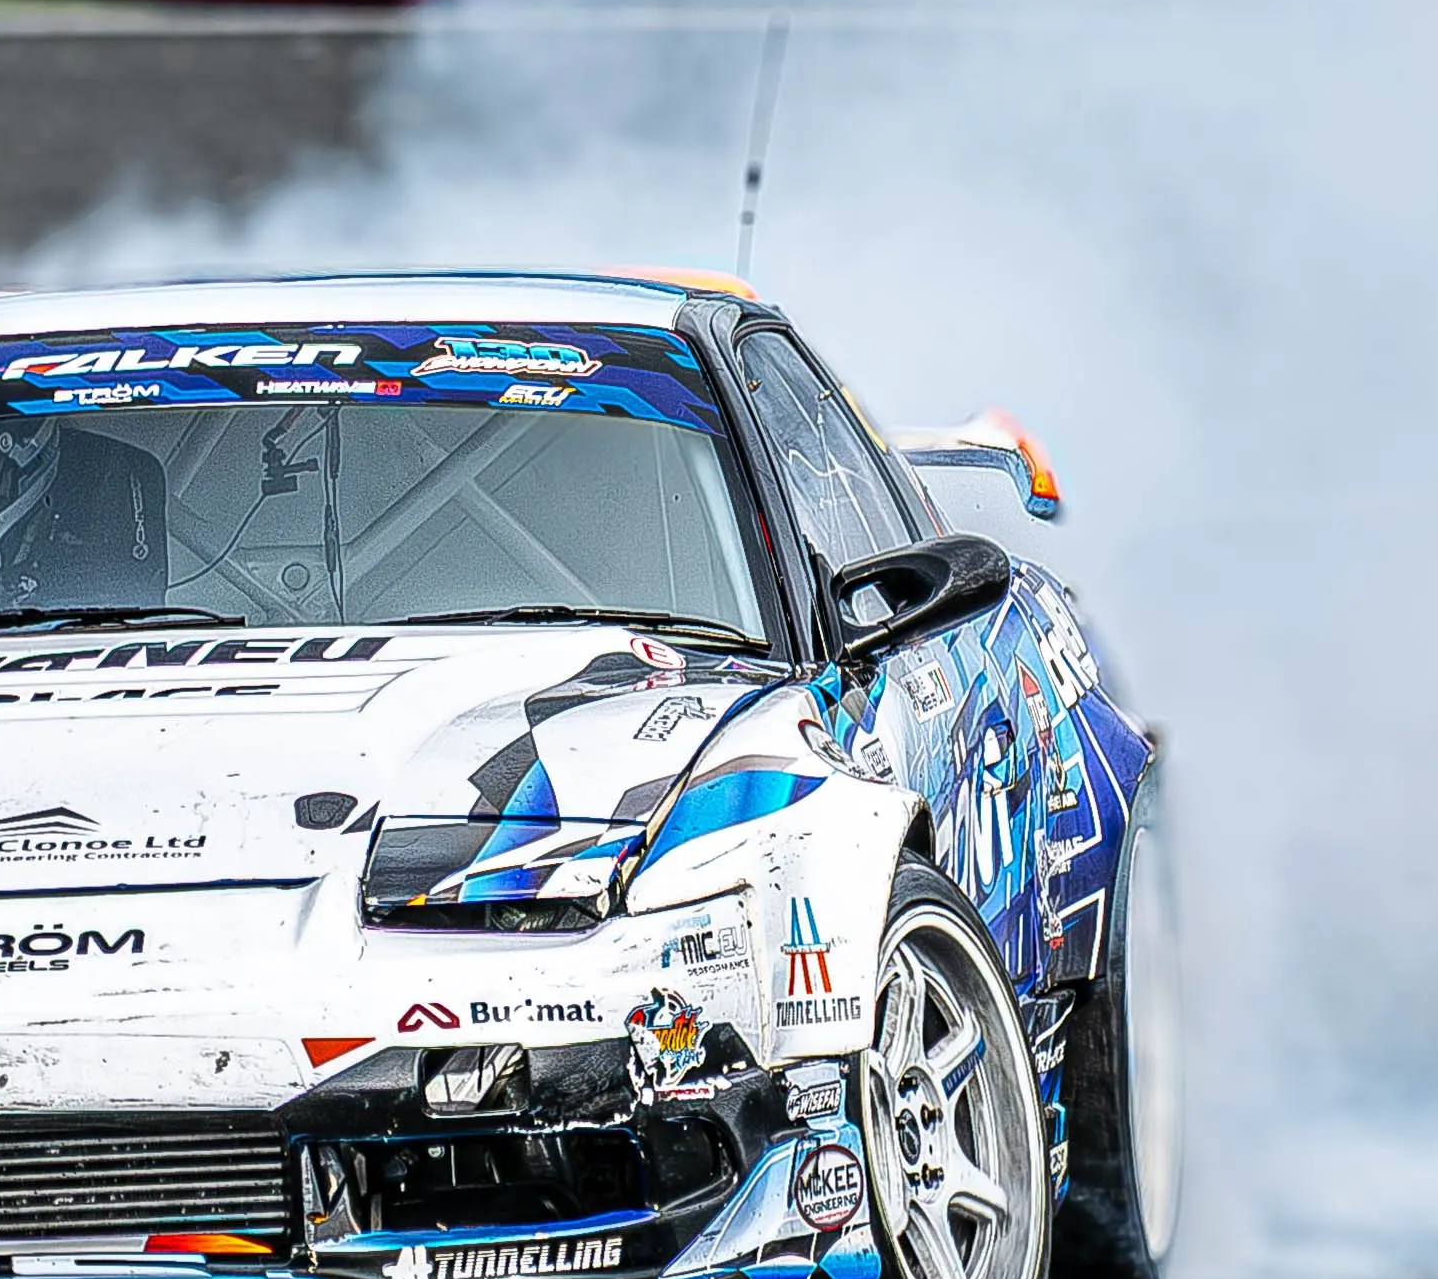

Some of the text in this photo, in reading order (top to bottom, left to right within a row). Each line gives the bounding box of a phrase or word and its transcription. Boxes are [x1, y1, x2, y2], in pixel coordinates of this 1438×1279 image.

[1, 344, 362, 380] FALKEN
[445, 339, 582, 365] 130
[256, 380, 376, 395] HEATWAVE
[145, 835, 207, 851] Ltd
[84, 849, 203, 861] Contractors
[471, 1001, 604, 1025] Bumat.
